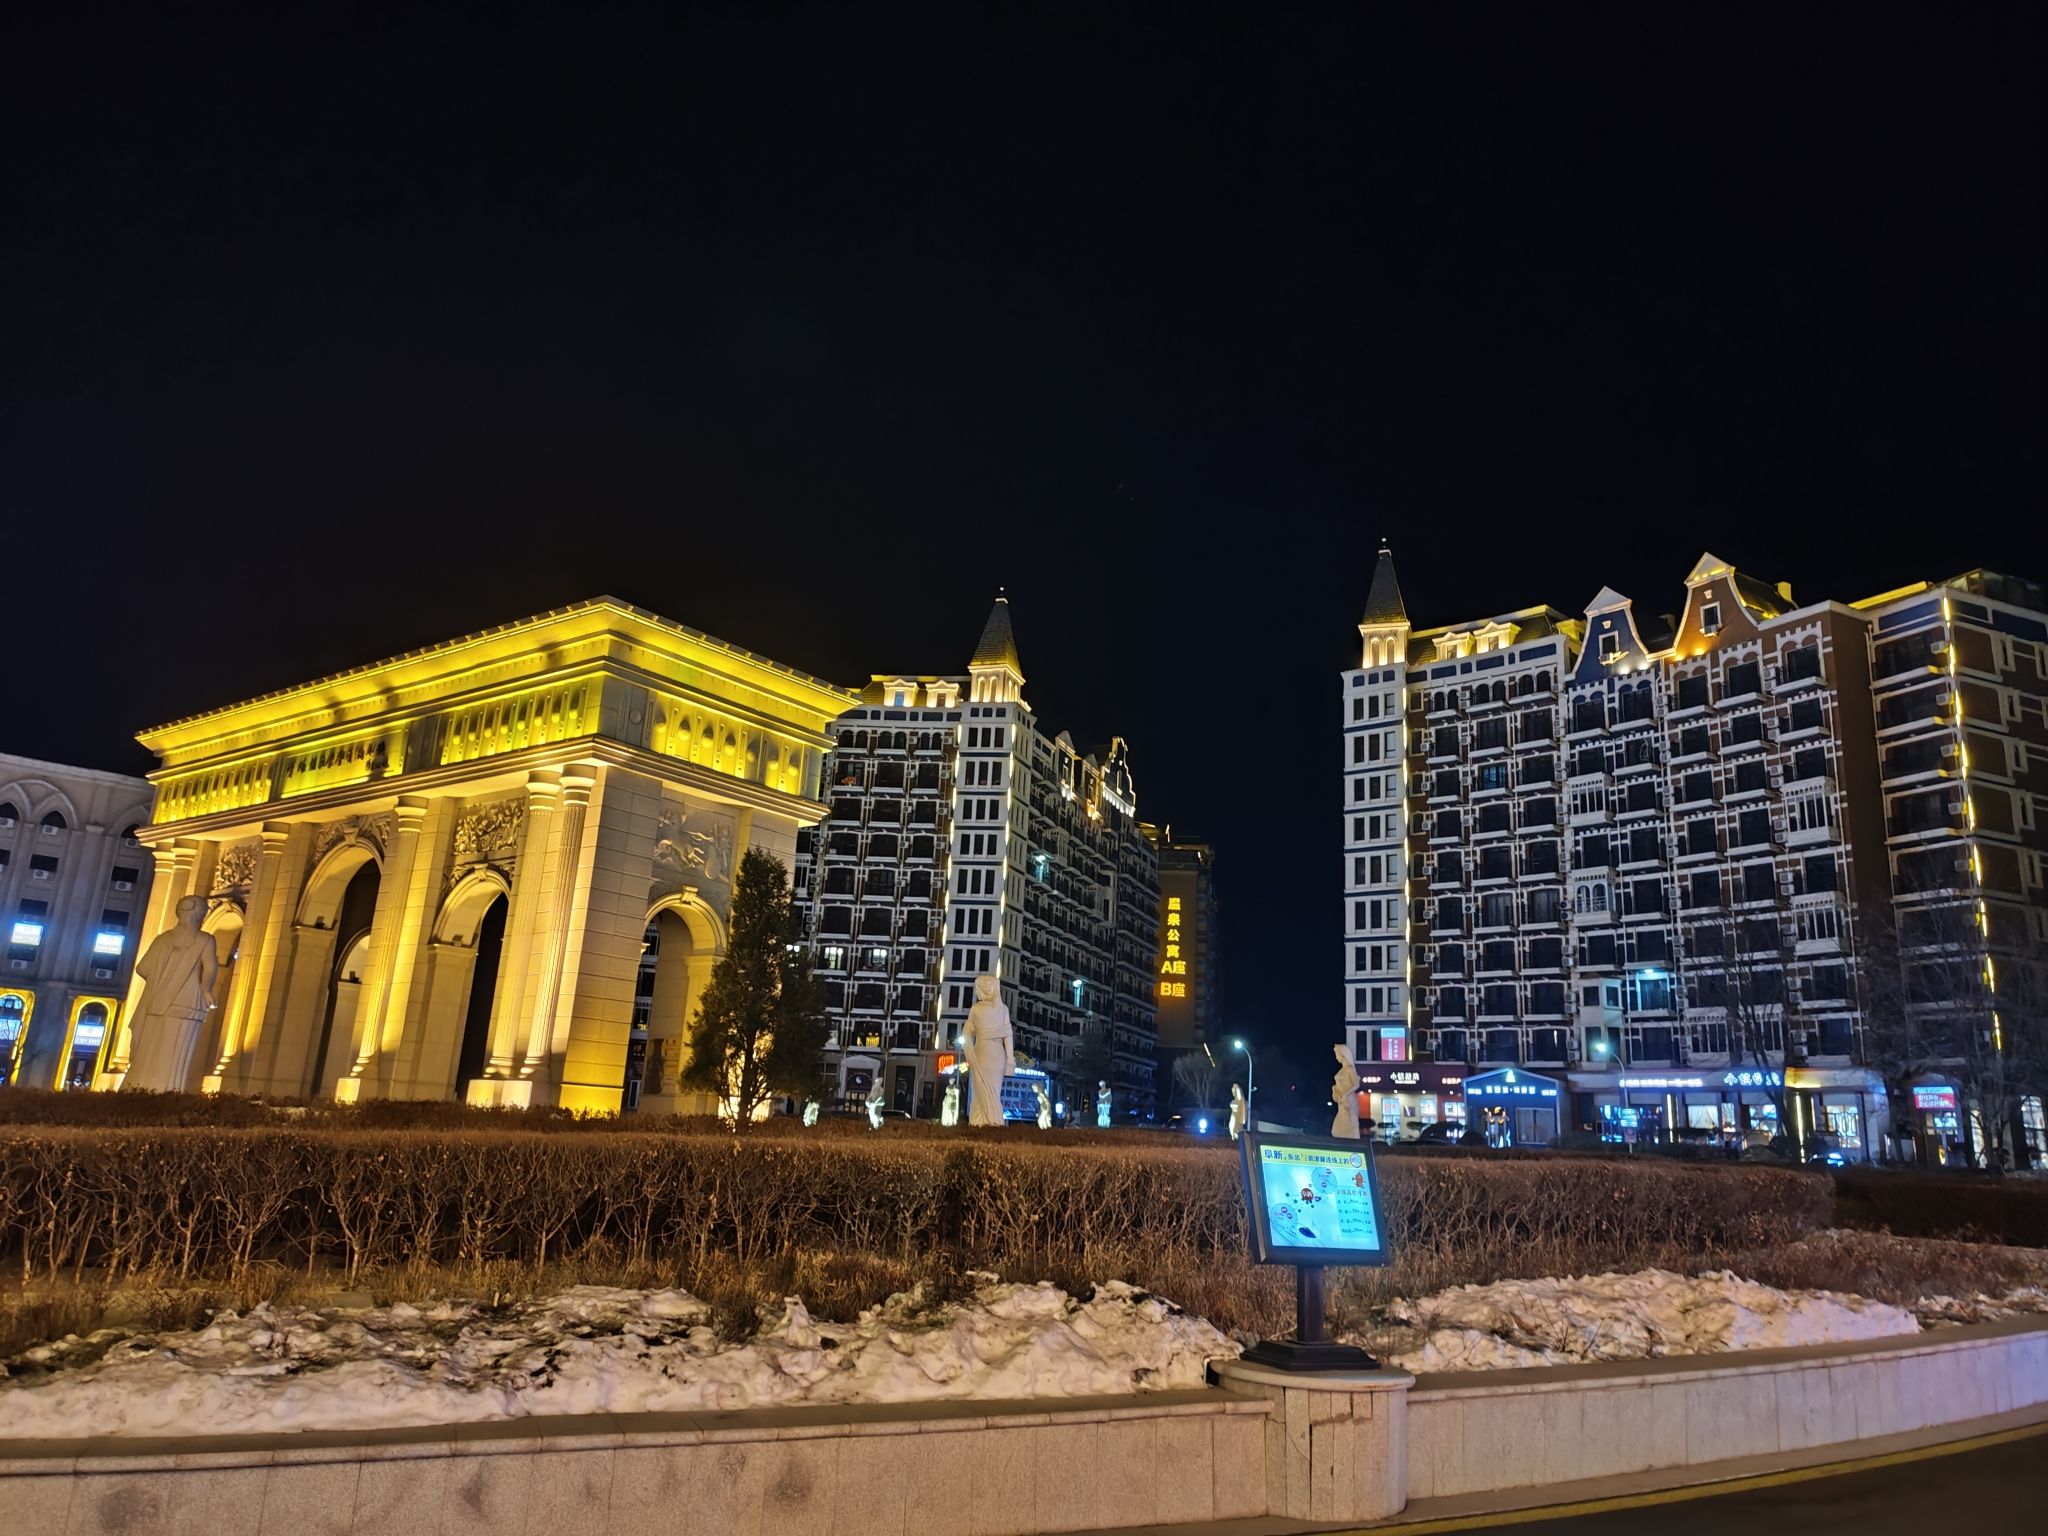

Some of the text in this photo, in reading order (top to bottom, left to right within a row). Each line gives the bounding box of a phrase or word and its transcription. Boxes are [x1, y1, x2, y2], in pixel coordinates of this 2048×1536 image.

[1166, 897, 1181, 958] 温泉公寓
[1161, 960, 1186, 975] A座
[1160, 982, 1185, 998] B座
